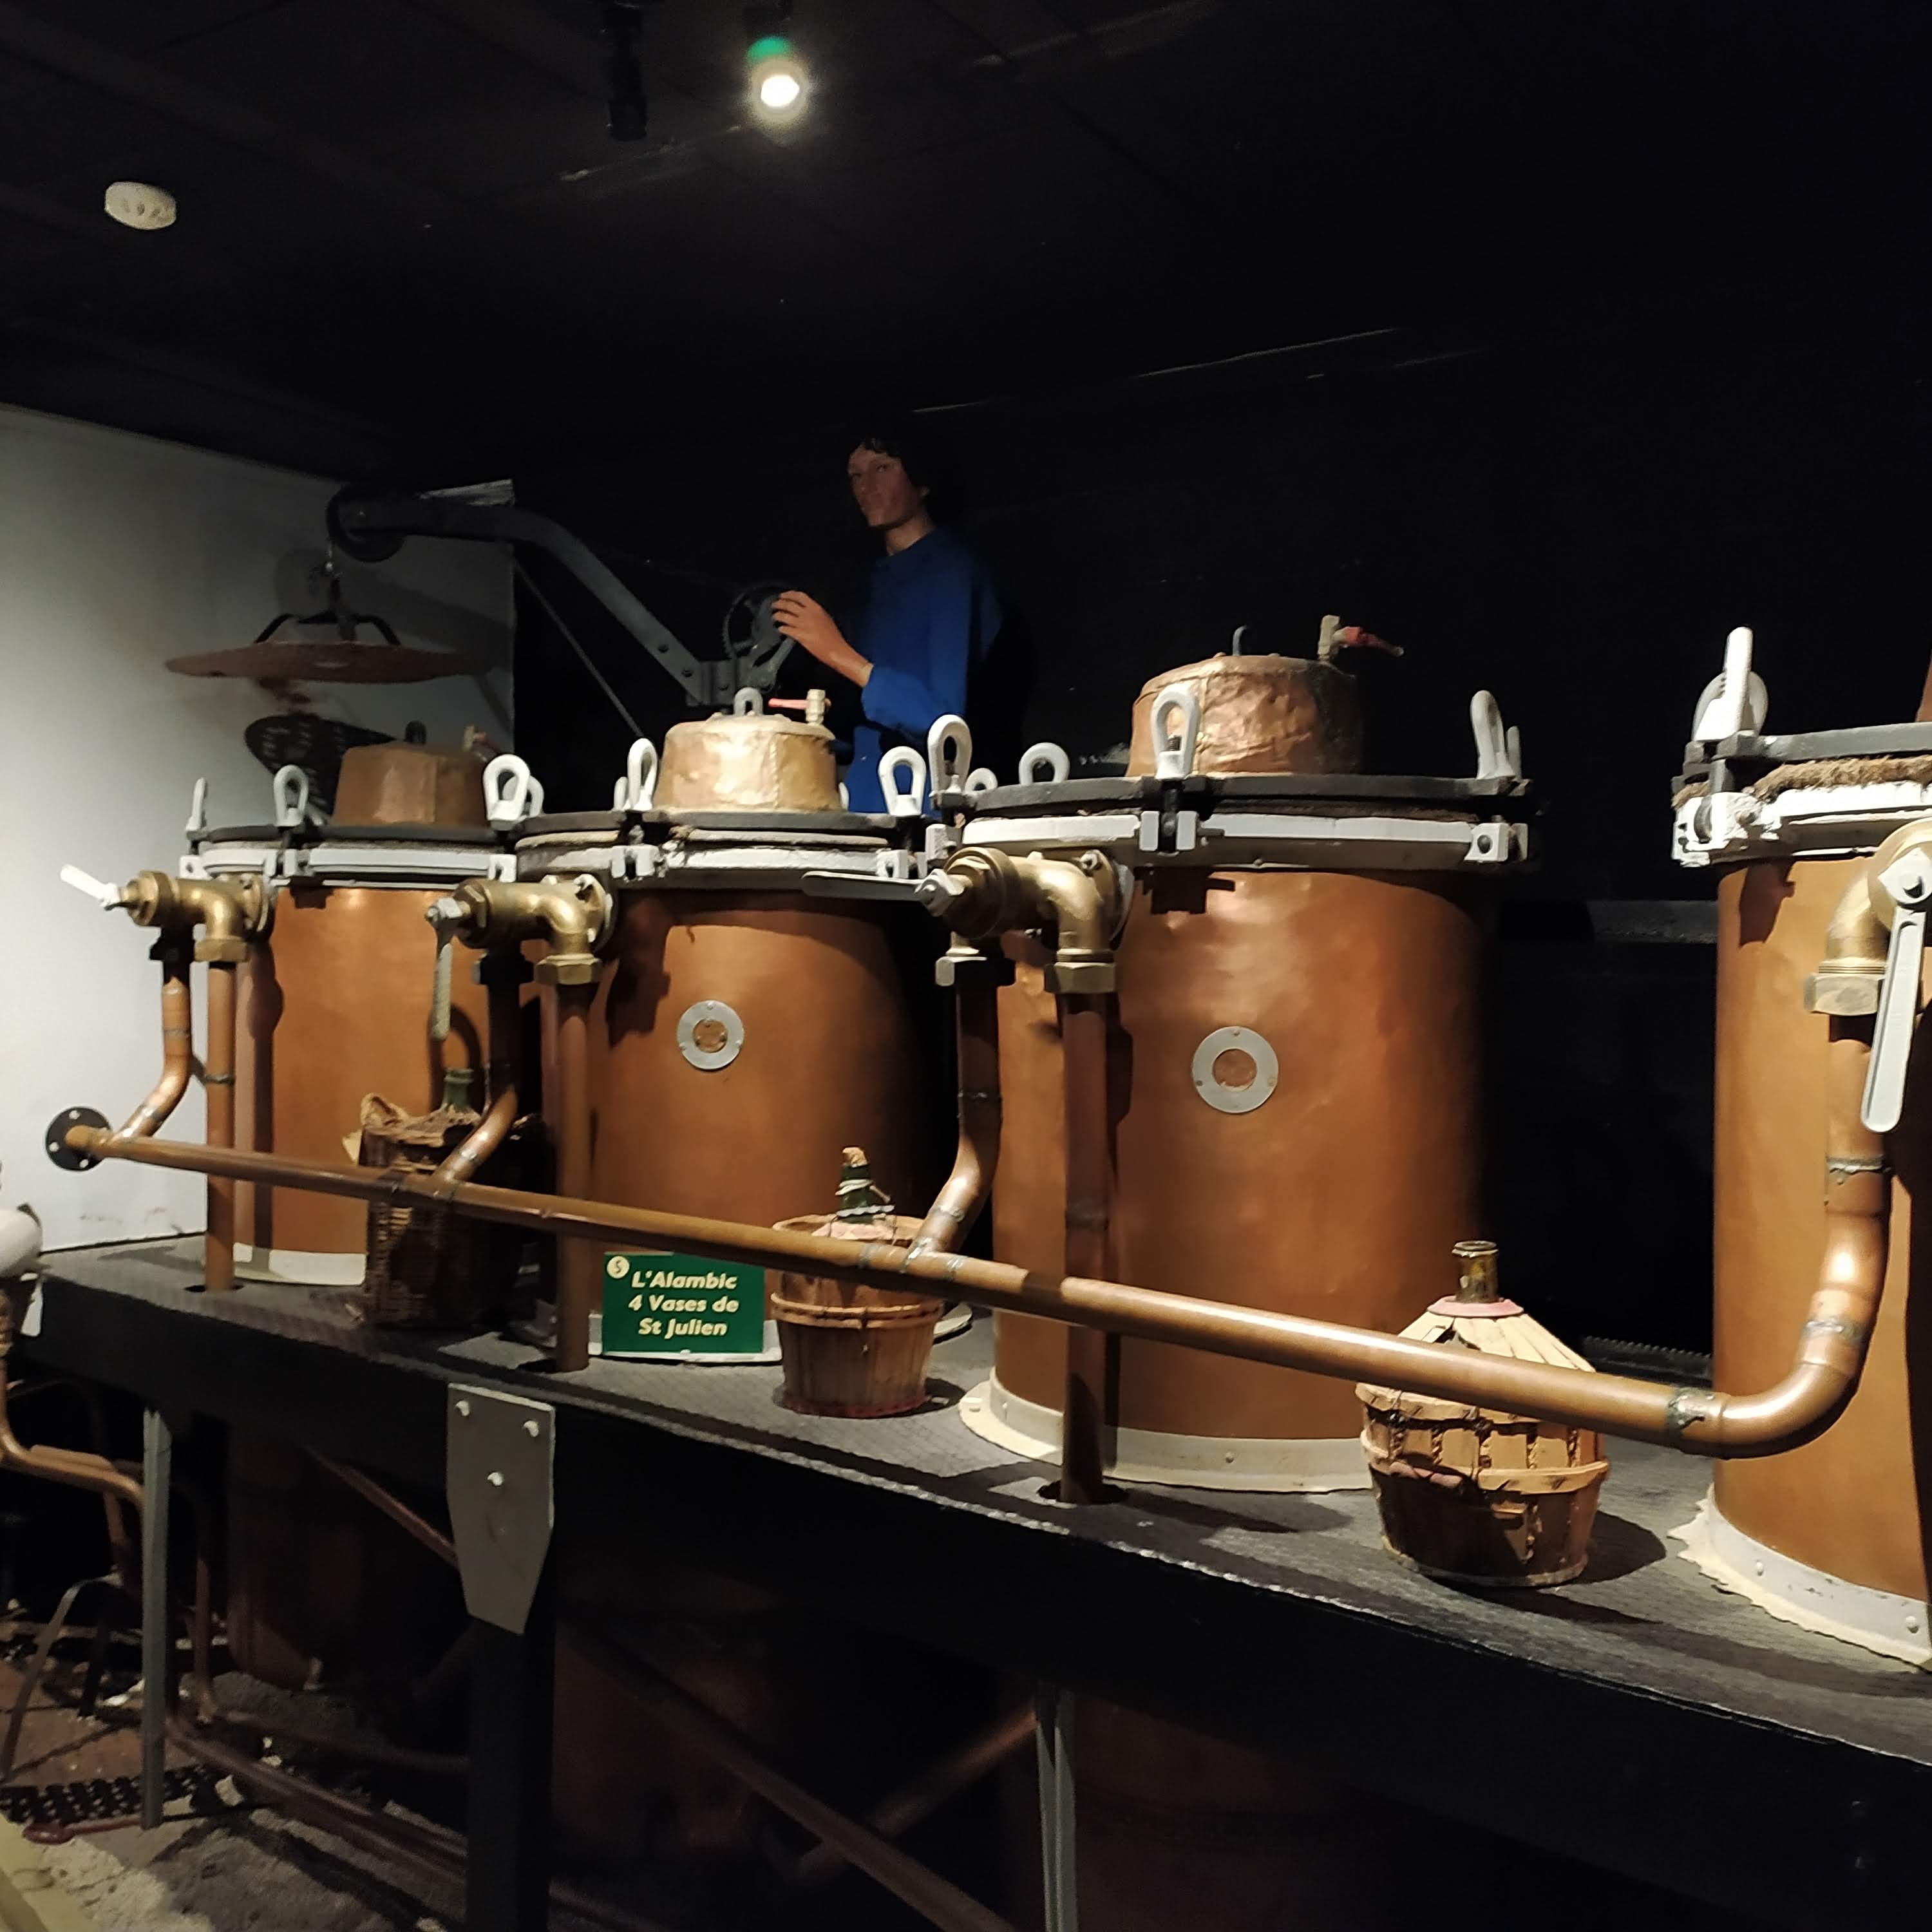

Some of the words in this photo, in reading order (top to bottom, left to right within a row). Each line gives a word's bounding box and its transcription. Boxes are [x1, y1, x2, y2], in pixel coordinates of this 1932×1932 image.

[631, 1271, 737, 1289] L'Alambic
[628, 1294, 643, 1311] 4
[649, 1294, 707, 1312] Vases
[712, 1296, 739, 1312] de
[638, 1318, 662, 1335] St
[664, 1318, 727, 1340] Julien
